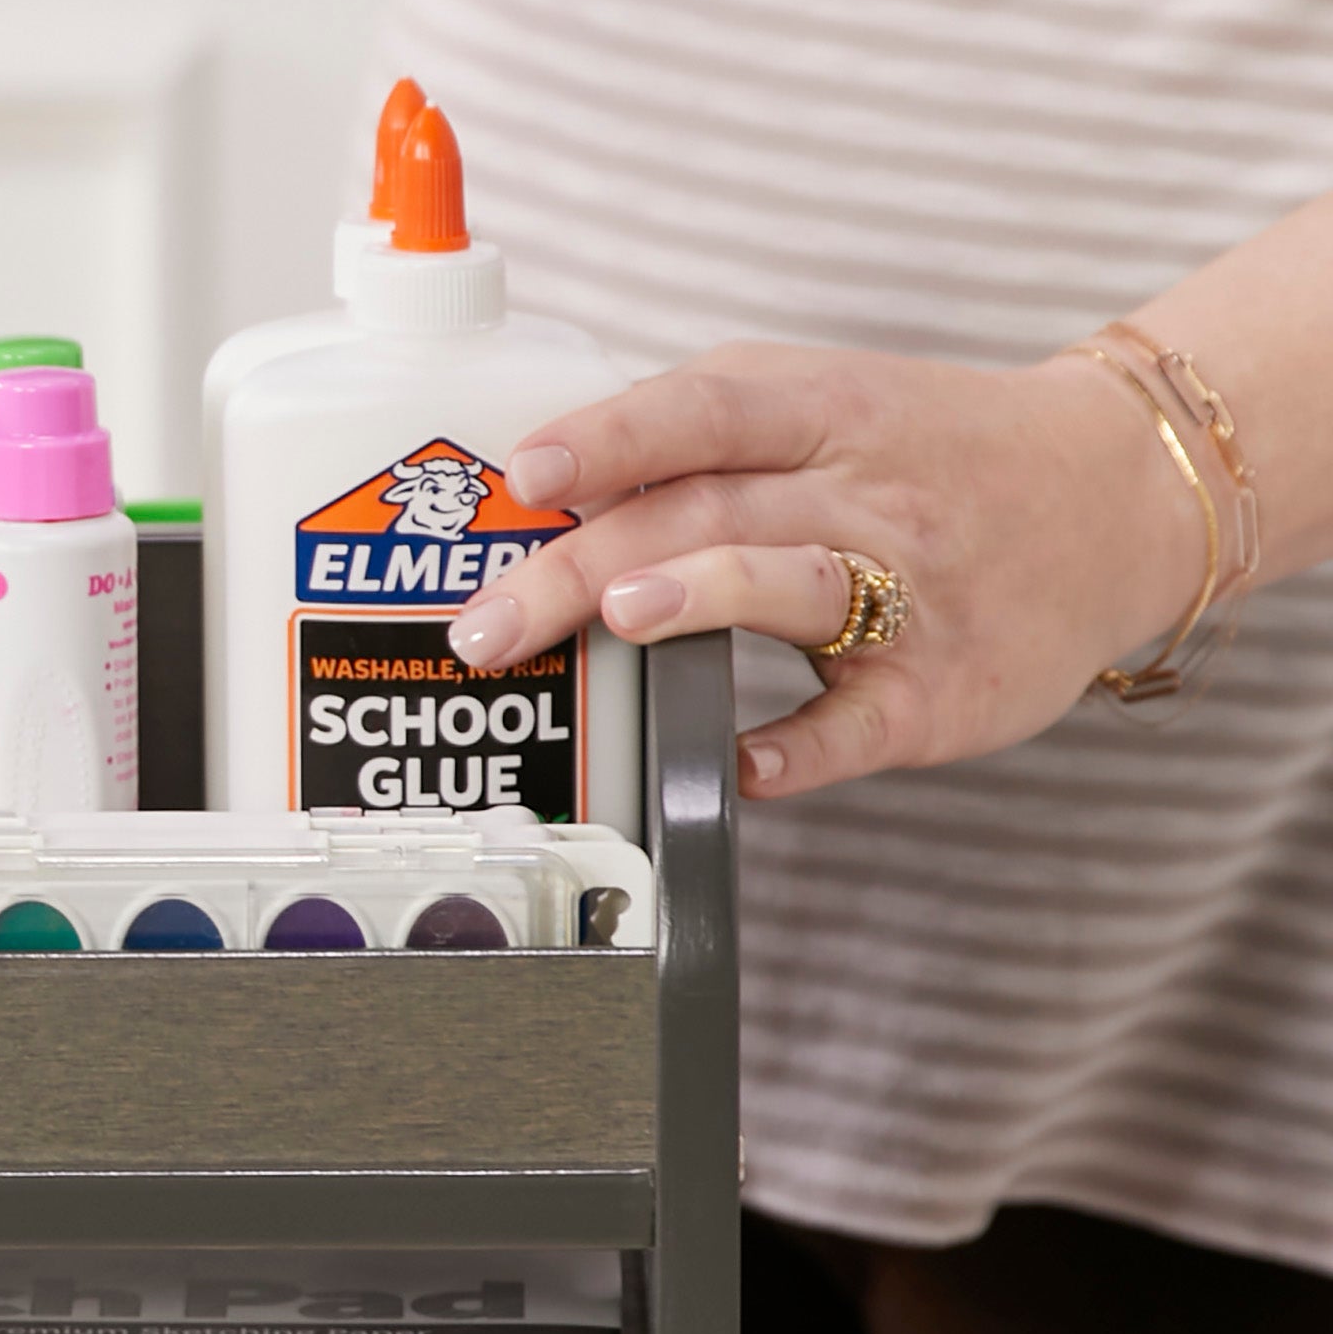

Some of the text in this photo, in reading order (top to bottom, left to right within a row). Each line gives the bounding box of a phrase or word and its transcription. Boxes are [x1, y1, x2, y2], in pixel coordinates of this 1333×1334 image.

[310, 655, 465, 685] WASHABLE,
[308, 692, 570, 747] SCHOOL
[357, 754, 523, 808] GLUE
[186, 1278, 525, 1320] Pad
